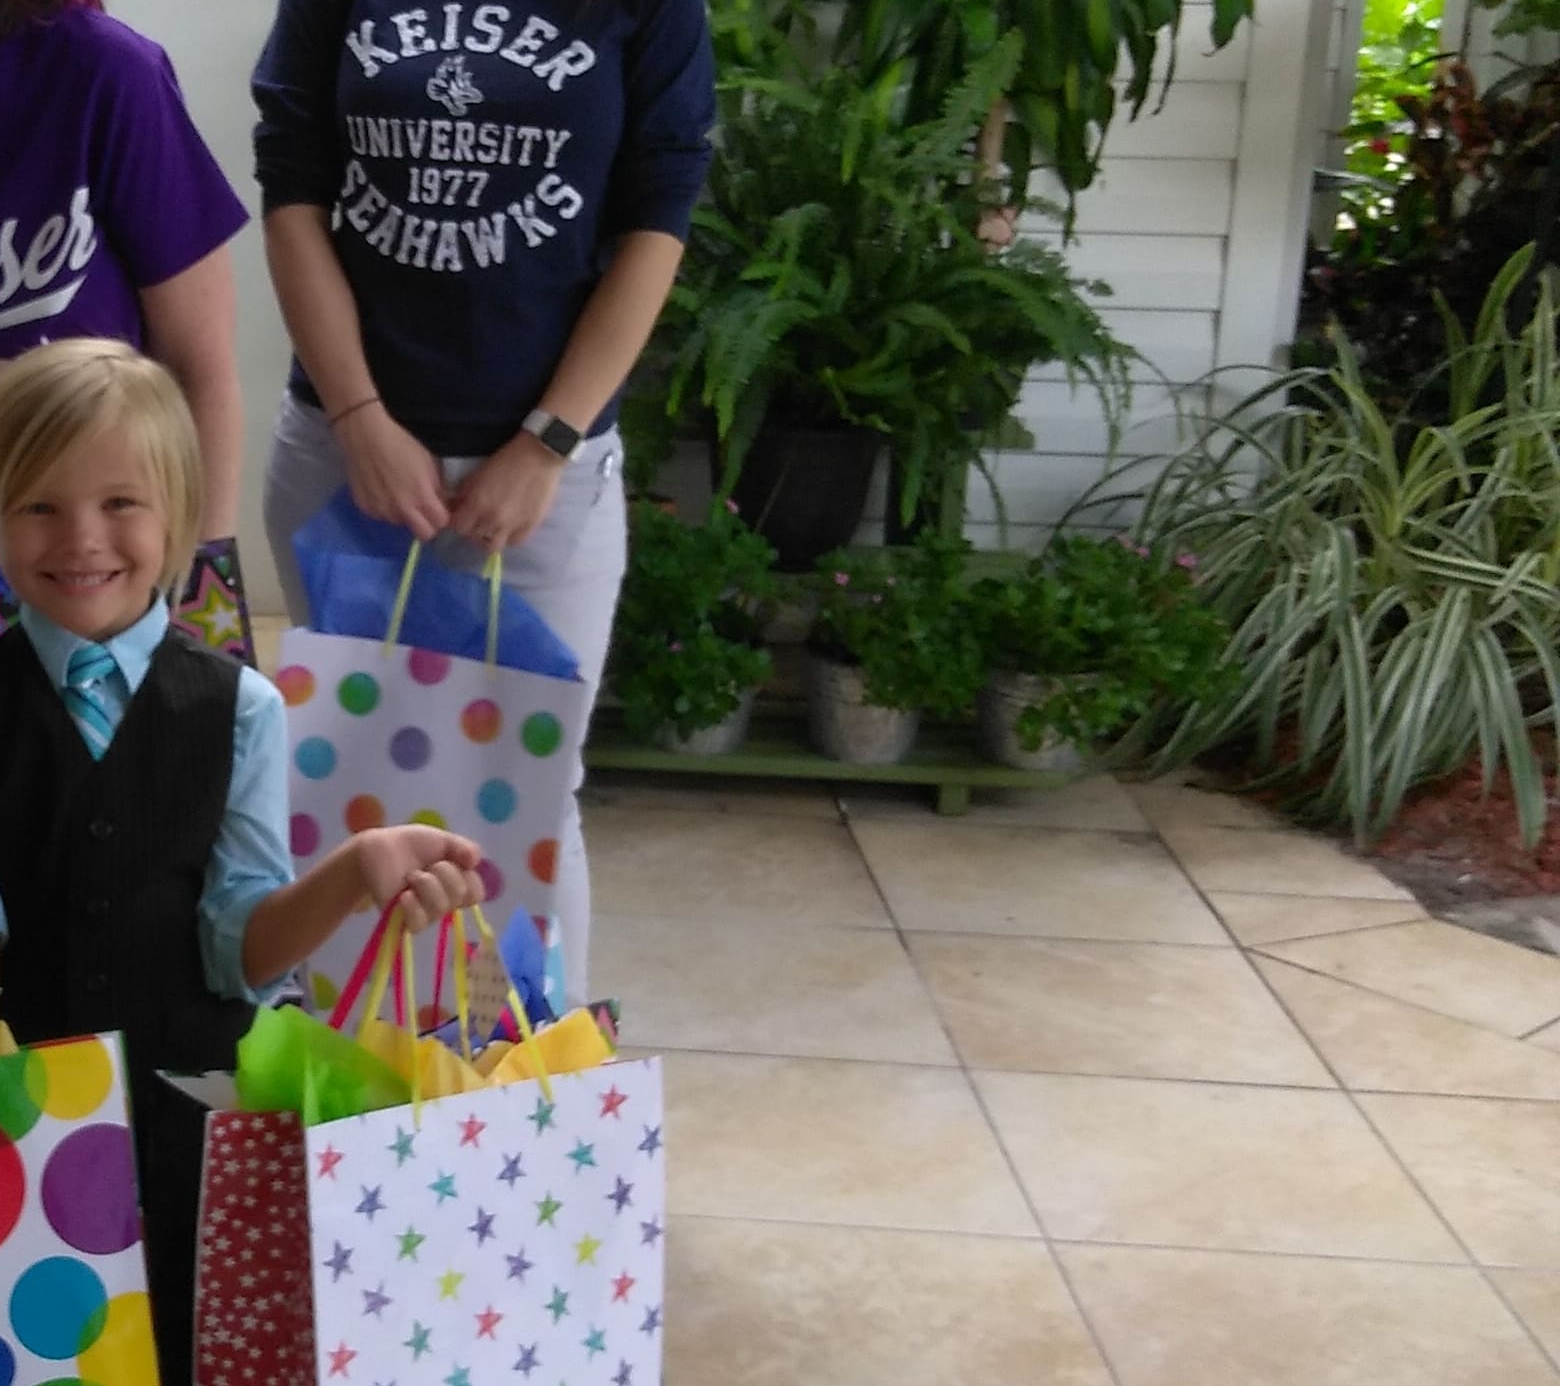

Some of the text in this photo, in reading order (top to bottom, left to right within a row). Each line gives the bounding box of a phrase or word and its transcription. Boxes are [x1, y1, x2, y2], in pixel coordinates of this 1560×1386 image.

[346, 3, 597, 93] KEISER
[346, 114, 572, 169] UNIVERSITY
[341, 158, 585, 273] SEAHAWKS
[406, 166, 490, 208] 1977
